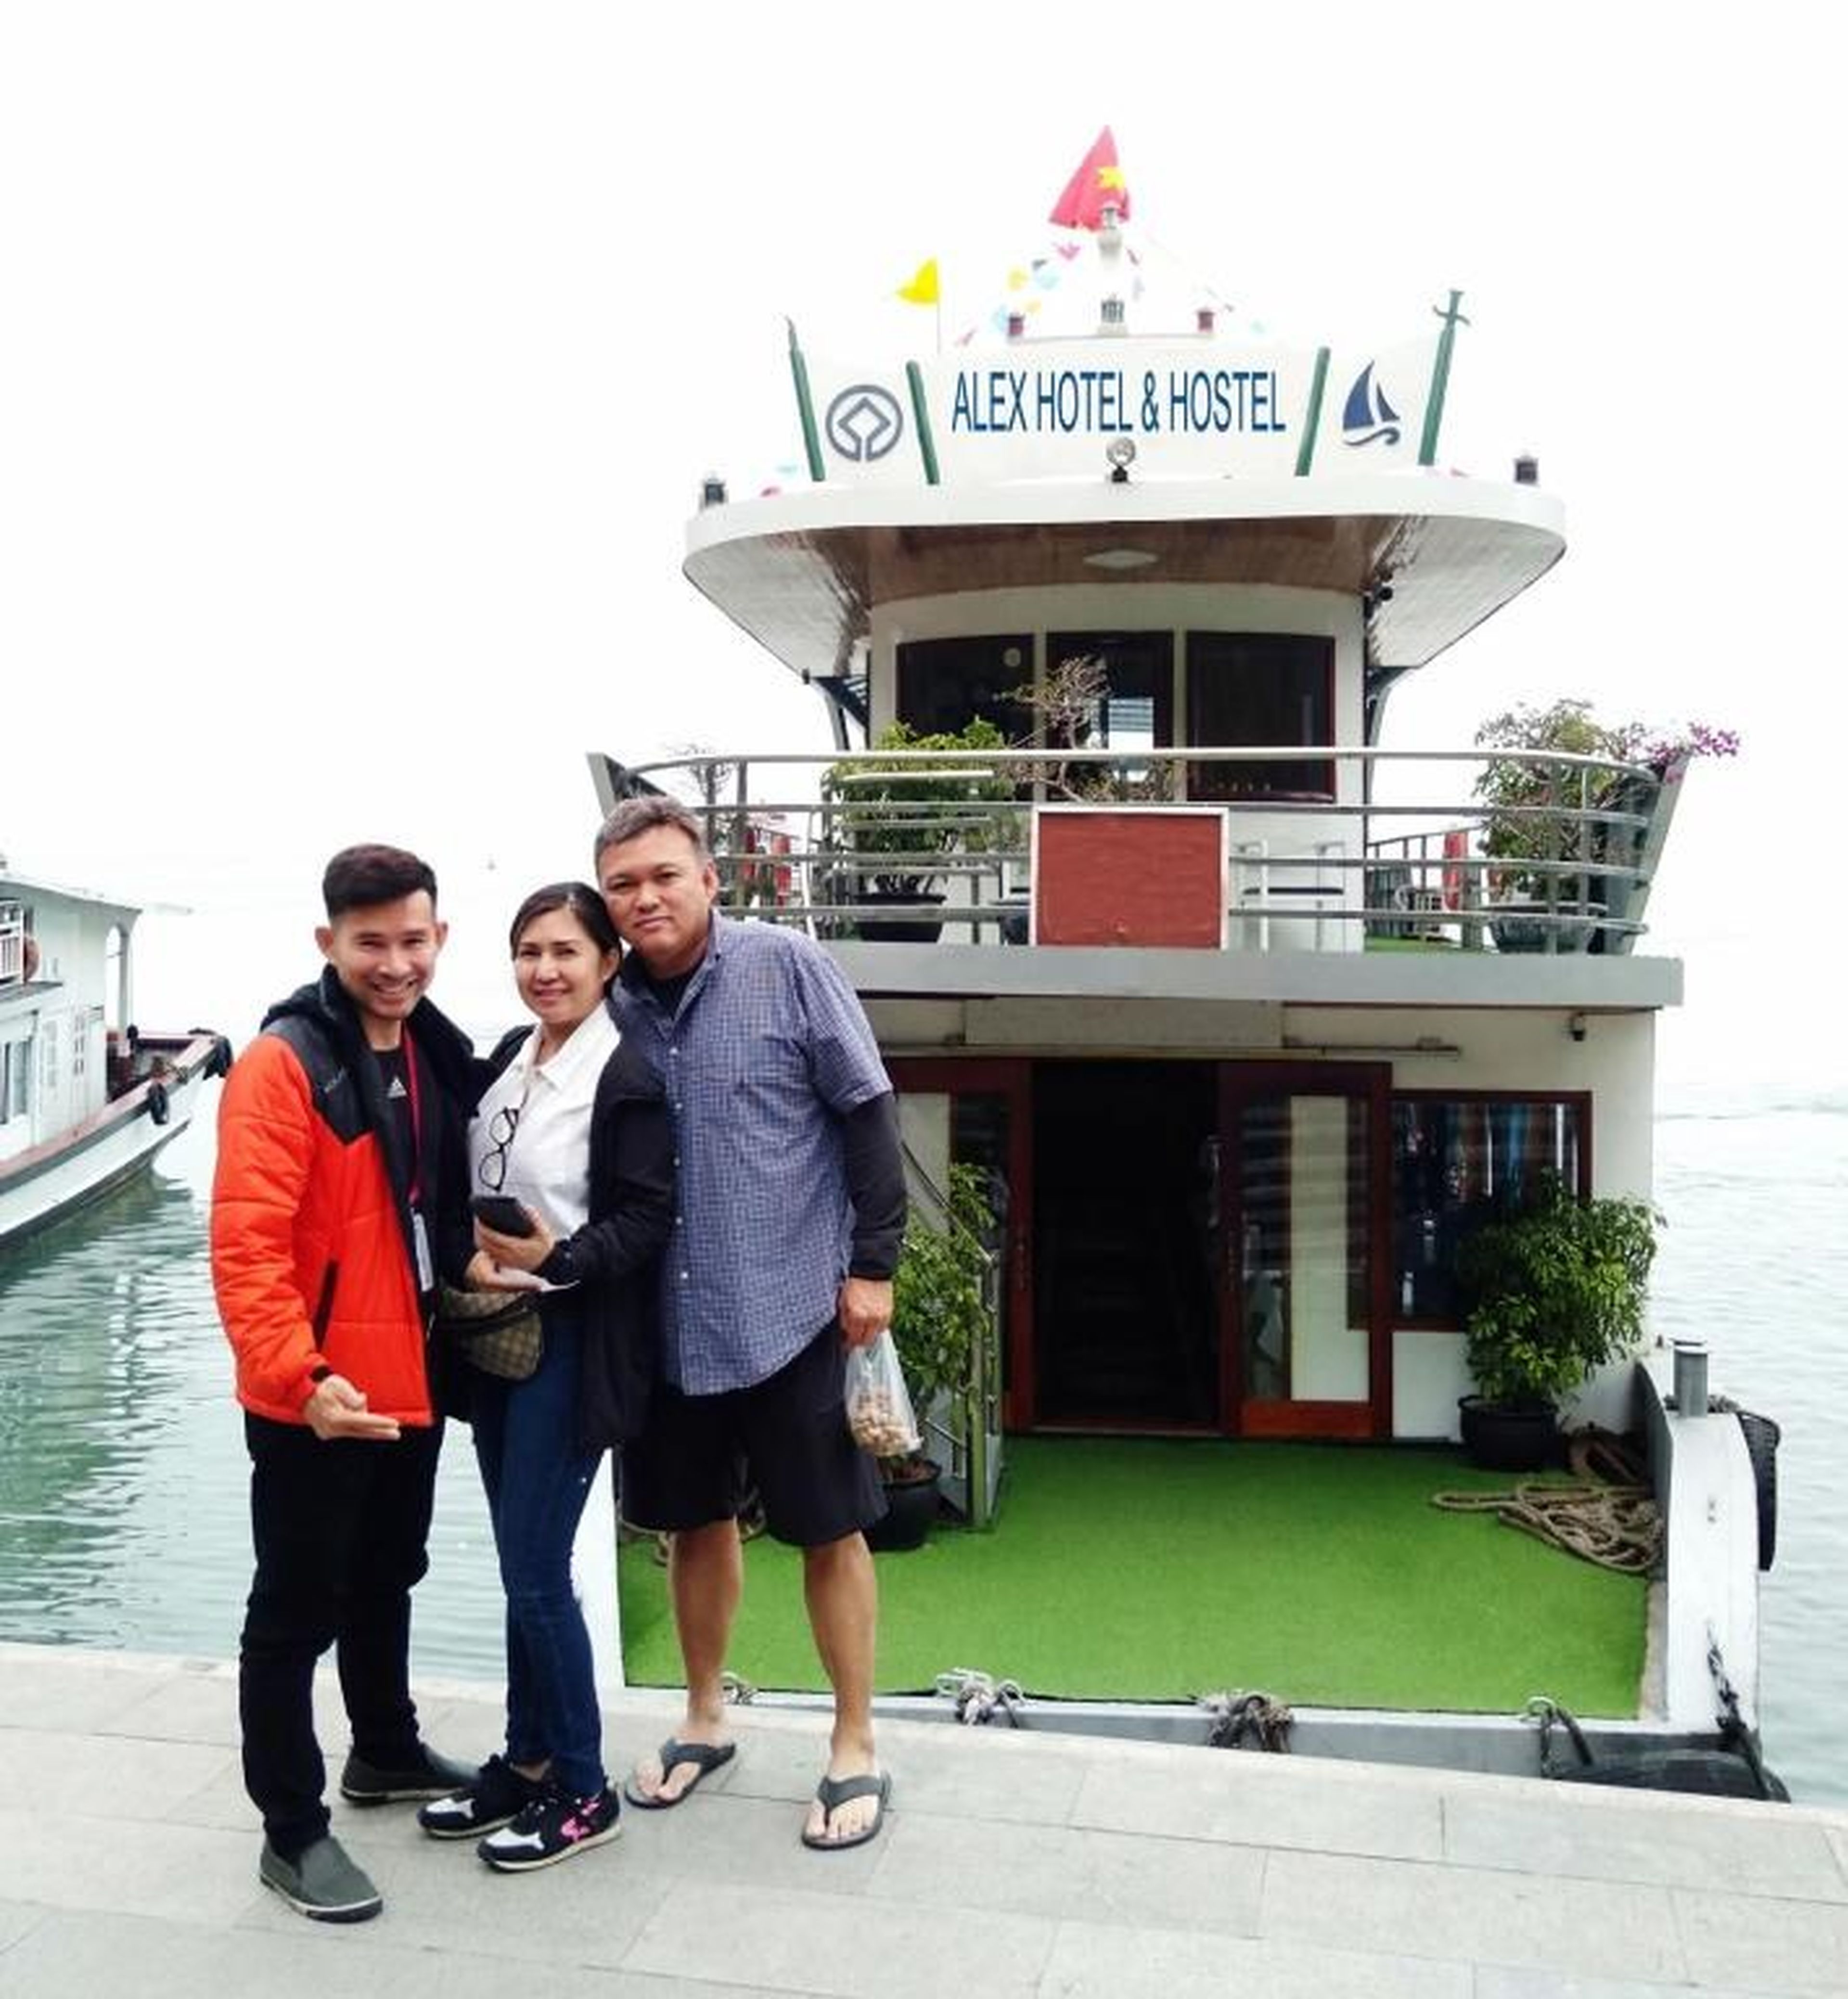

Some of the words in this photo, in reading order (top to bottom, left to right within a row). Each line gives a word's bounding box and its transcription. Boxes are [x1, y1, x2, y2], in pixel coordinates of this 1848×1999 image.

[951, 371, 1028, 432] ALEX
[1037, 371, 1134, 432] HOTEL
[1141, 370, 1160, 432] &
[1170, 371, 1286, 432] HOSTEL
